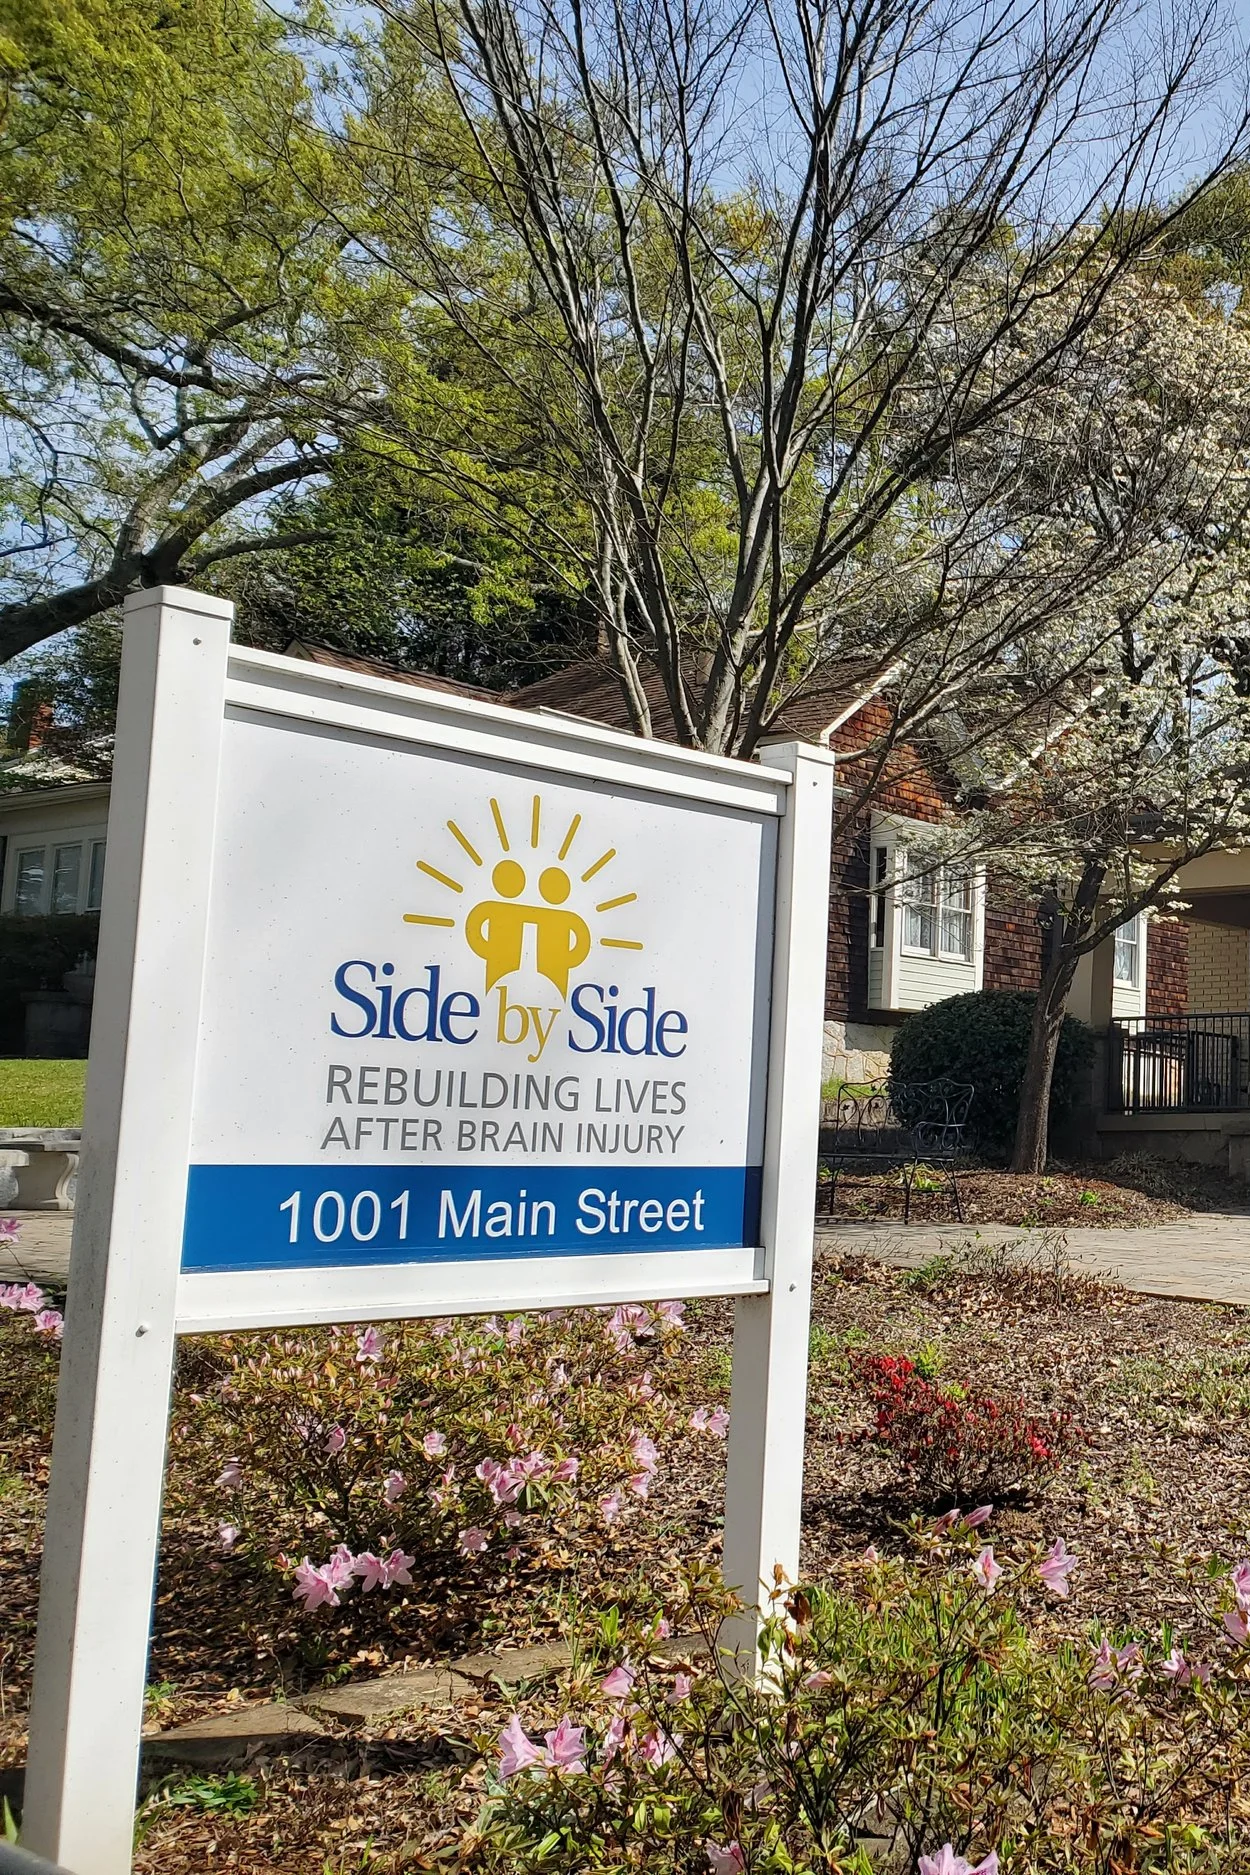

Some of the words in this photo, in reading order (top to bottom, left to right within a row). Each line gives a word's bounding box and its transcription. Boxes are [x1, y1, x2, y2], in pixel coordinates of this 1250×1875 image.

[330, 960, 479, 1045] Side
[496, 985, 560, 1063] by
[568, 983, 687, 1058] Side
[325, 1064, 580, 1112] REBUILDING
[596, 1079, 687, 1115] LIVES
[321, 1116, 443, 1152] AFTER
[458, 1121, 562, 1153] BRAIN
[577, 1124, 685, 1154] INJURY
[279, 1190, 409, 1243] 1001
[439, 1189, 555, 1239] Main
[575, 1188, 705, 1233] Street
